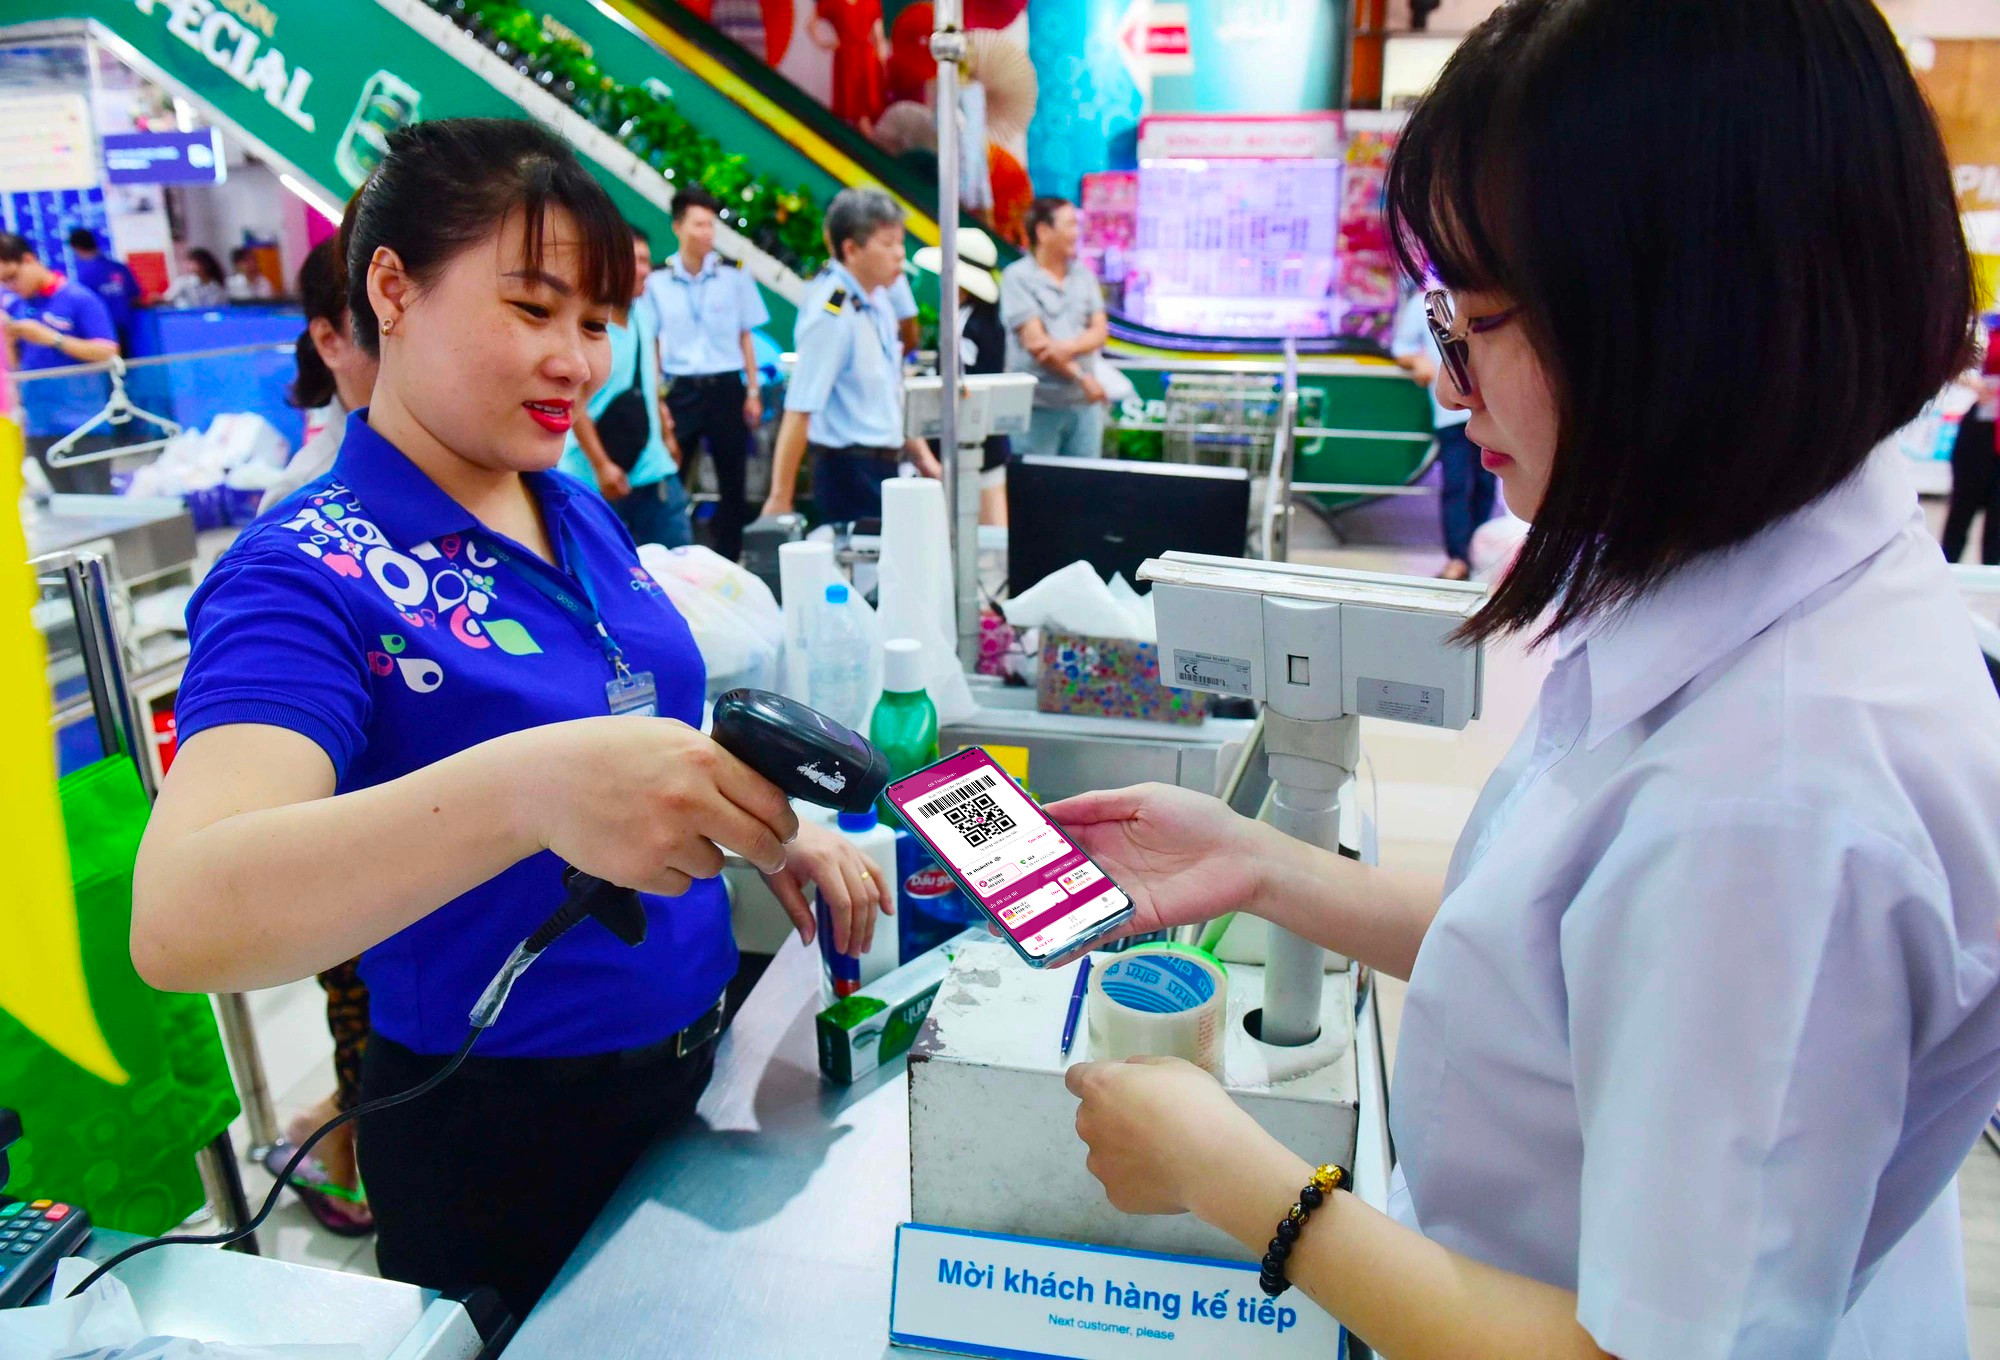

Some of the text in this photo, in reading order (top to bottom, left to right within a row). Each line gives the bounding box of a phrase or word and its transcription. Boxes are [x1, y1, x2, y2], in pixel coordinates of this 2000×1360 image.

[937, 1258, 1298, 1335] Mời khách hàng kế tiếp
[1048, 1313, 1176, 1341] Next customer, please
